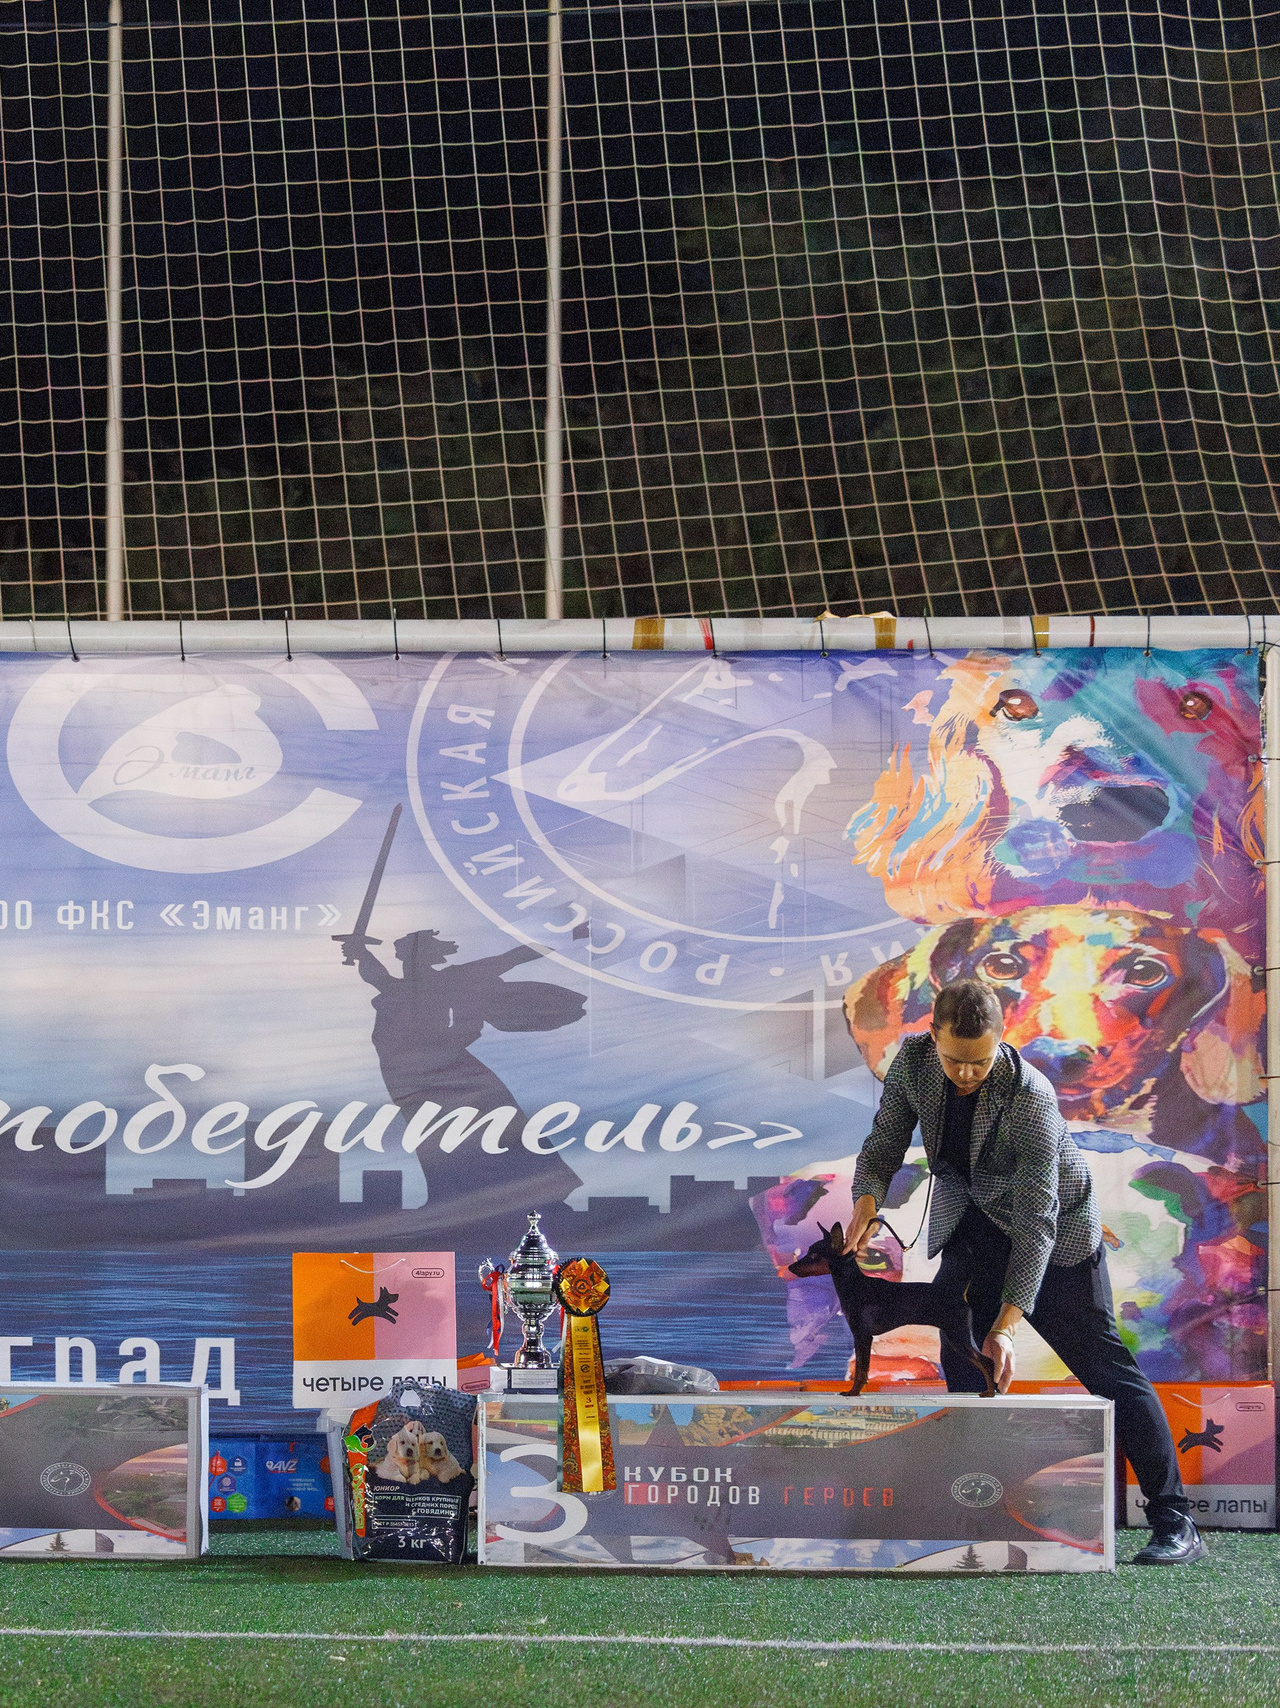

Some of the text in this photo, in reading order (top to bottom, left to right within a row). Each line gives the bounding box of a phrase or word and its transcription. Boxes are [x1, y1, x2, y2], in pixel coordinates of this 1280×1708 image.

[439, 704, 730, 986] РОССИЙСКАЯ
[56, 900, 134, 930] ФКС
[159, 900, 342, 930] «Эманг»
[303, 1376, 383, 1391] четыре
[271, 1460, 298, 1471] AVZ
[624, 1466, 732, 1483] КУБОК
[495, 1443, 588, 1544] 3
[628, 1485, 894, 1507] ГОРОДОВ ГЕРОЕВ
[1215, 1499, 1267, 1513] лапы
[398, 1535, 406, 1549] 3
